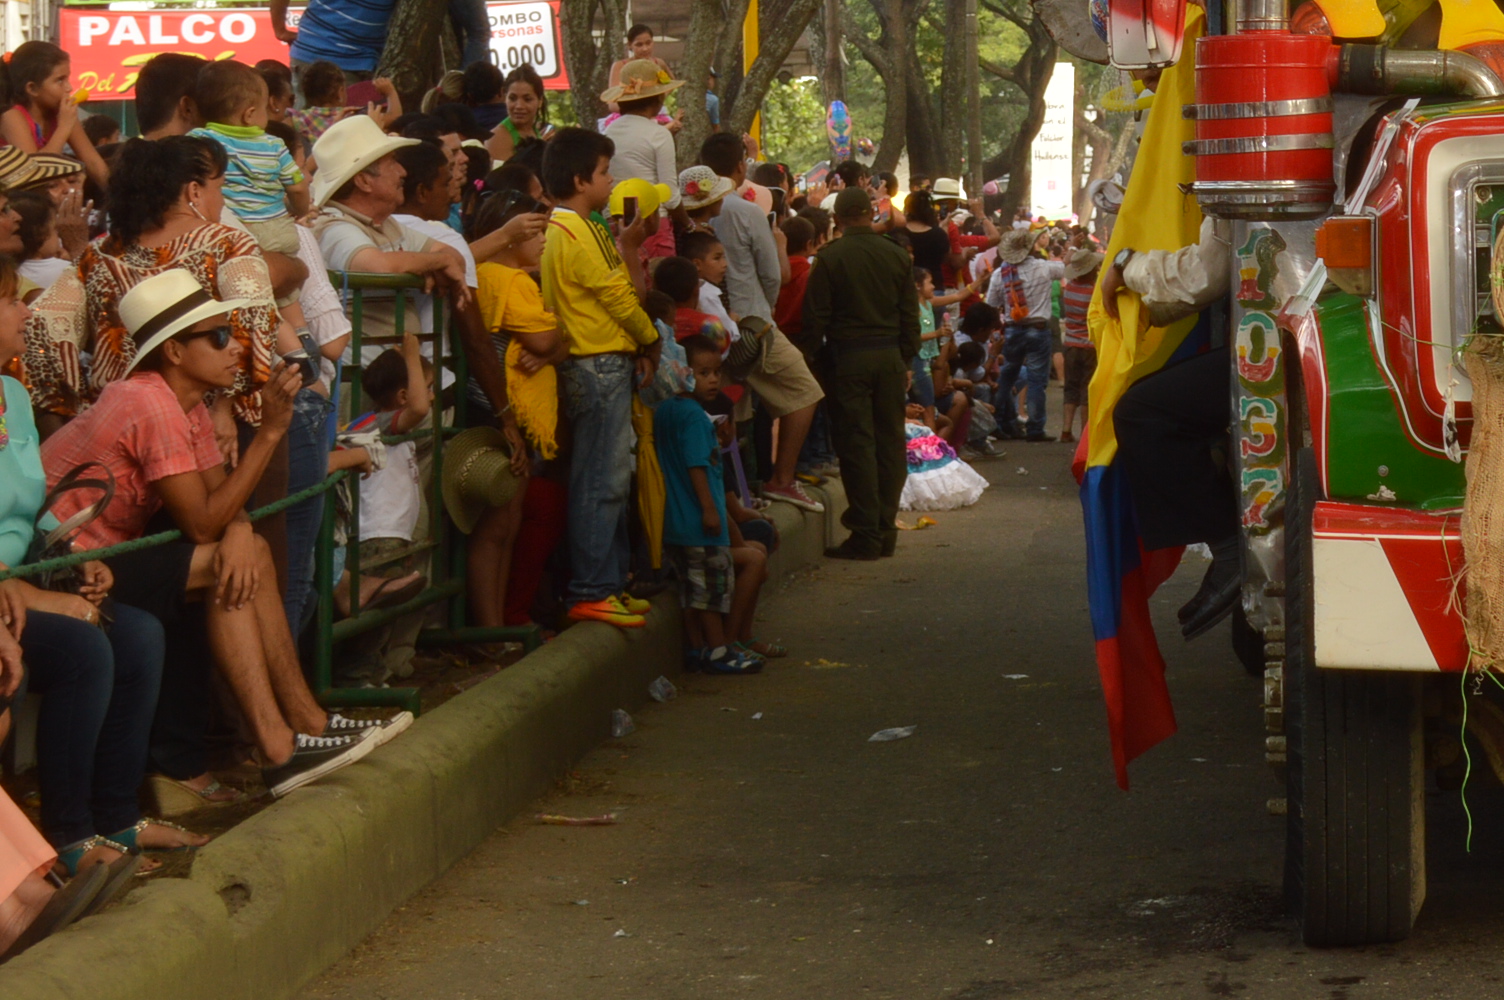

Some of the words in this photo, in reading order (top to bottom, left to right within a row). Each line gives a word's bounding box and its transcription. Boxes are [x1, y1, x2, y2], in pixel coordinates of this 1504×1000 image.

[78, 12, 257, 46] PALCO
[489, 11, 542, 27] OMBO
[491, 25, 544, 39] rsonas
[489, 43, 546, 69] 0.000
[78, 71, 114, 92] Del
